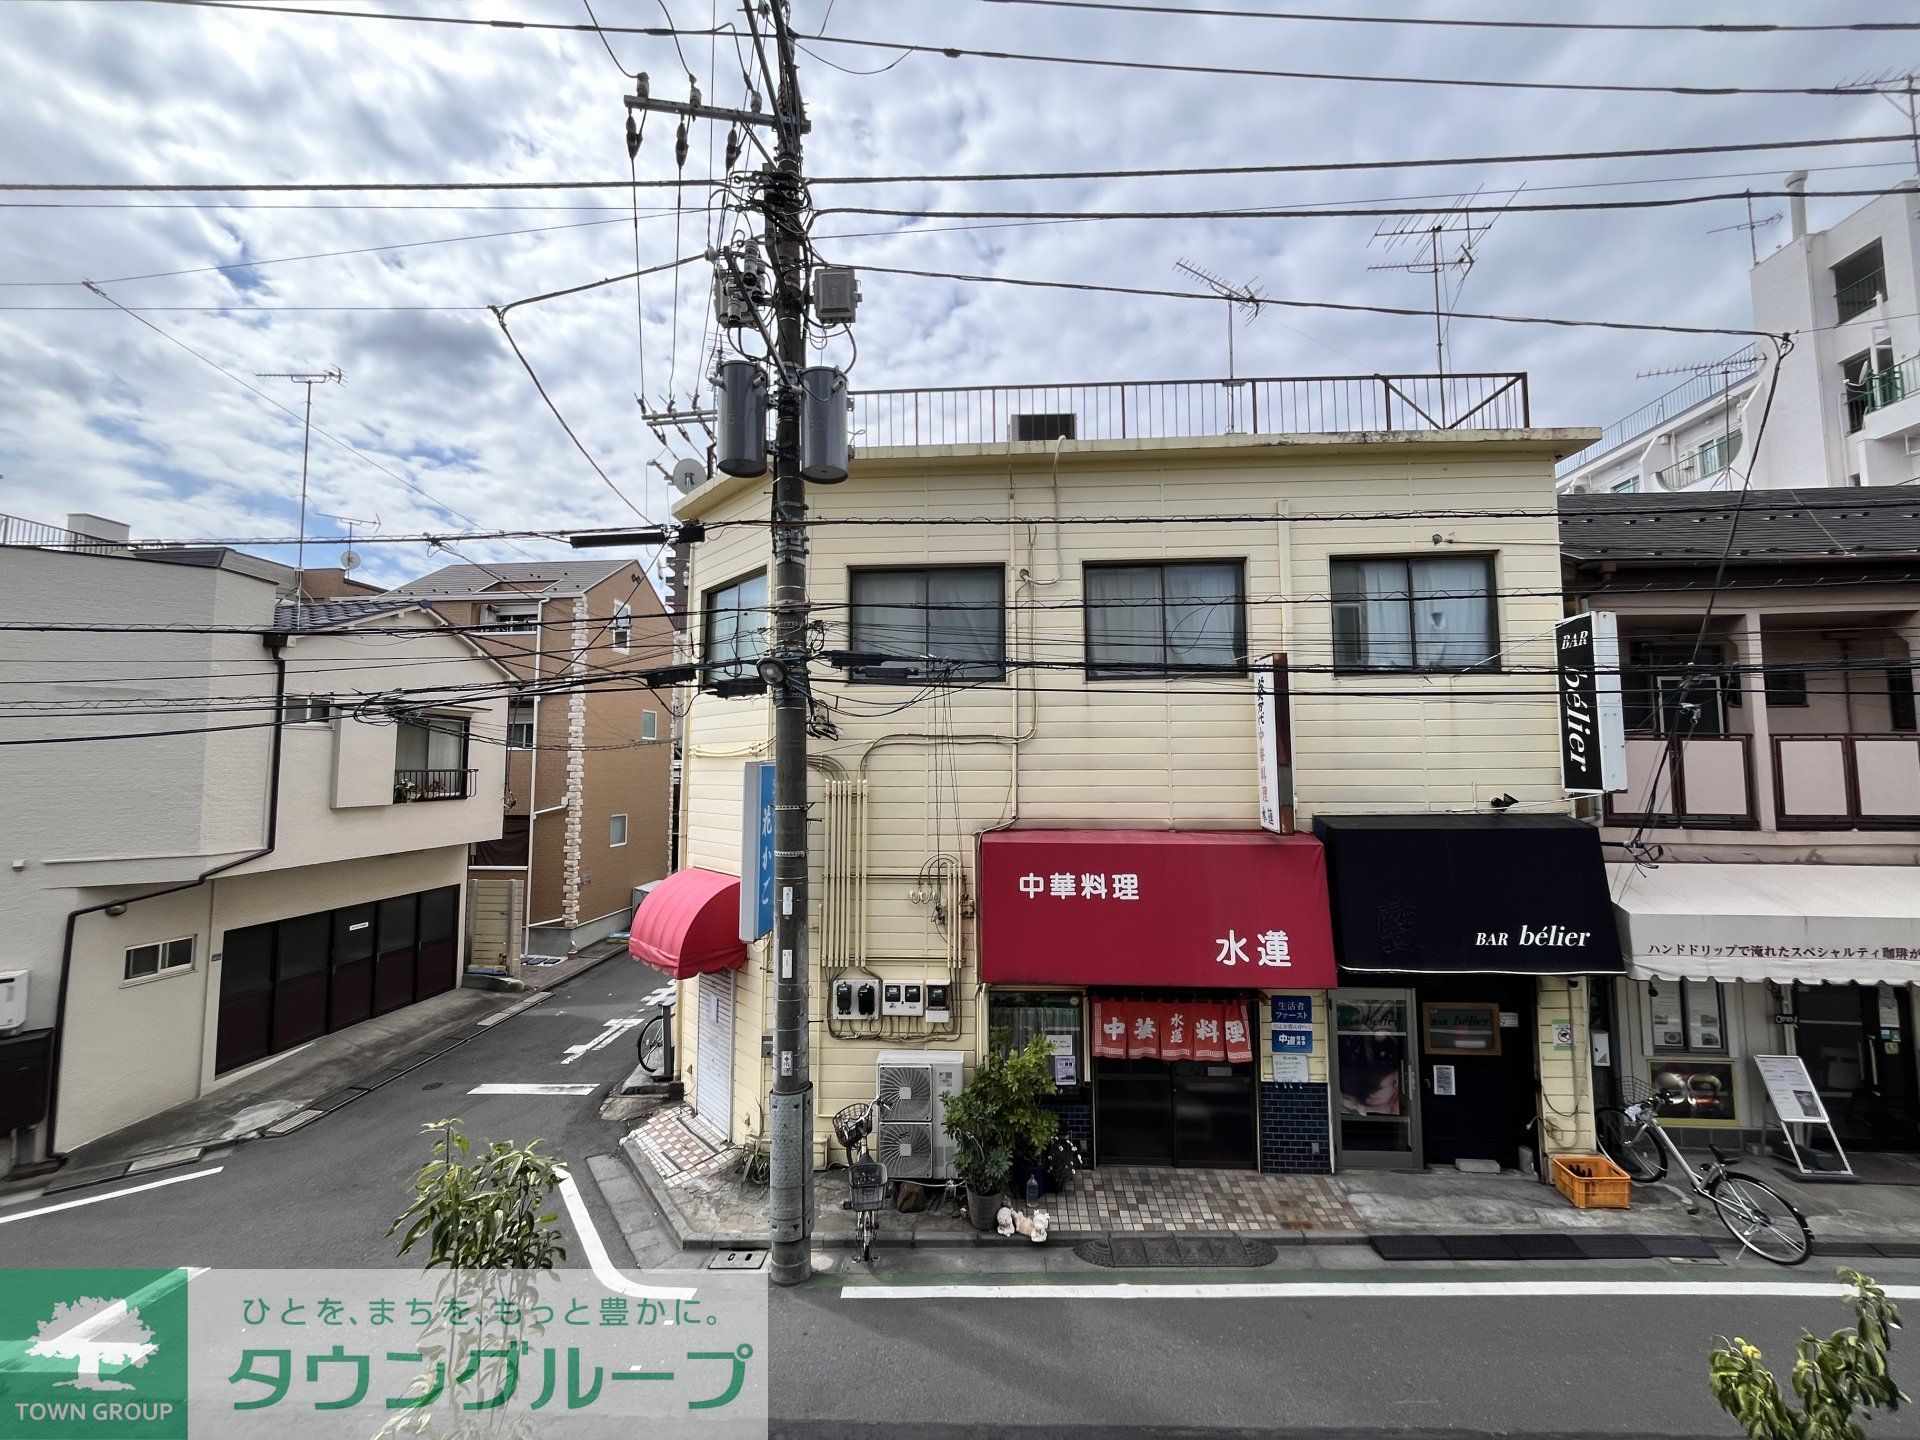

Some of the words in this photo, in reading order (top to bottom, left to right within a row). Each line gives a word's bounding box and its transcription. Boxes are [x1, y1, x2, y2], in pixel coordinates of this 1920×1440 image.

[1561, 630, 1588, 650] BAR
[1564, 665, 1592, 773] bélier
[1019, 872, 1140, 900] 中華料理
[1475, 932, 1508, 946] BAR
[1519, 924, 1591, 947] bélier
[1215, 929, 1292, 967] 水蓮
[1275, 1012, 1308, 1020] ファースト
[1278, 1001, 1305, 1011] 生活者
